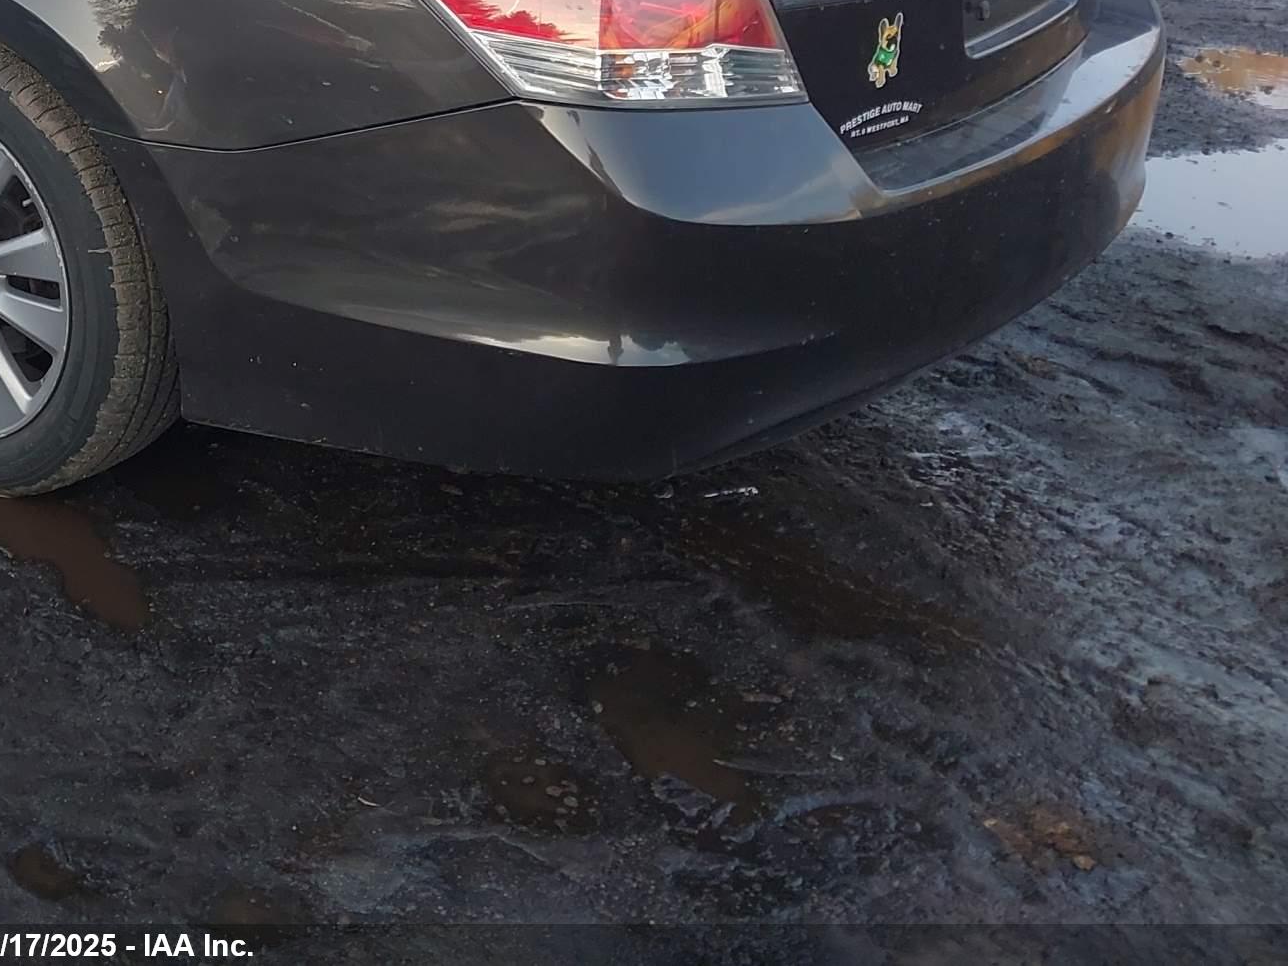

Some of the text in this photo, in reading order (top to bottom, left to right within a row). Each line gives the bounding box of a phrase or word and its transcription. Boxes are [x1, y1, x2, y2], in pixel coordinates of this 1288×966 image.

[839, 100, 923, 135] PRESTIGE AUTO MART
